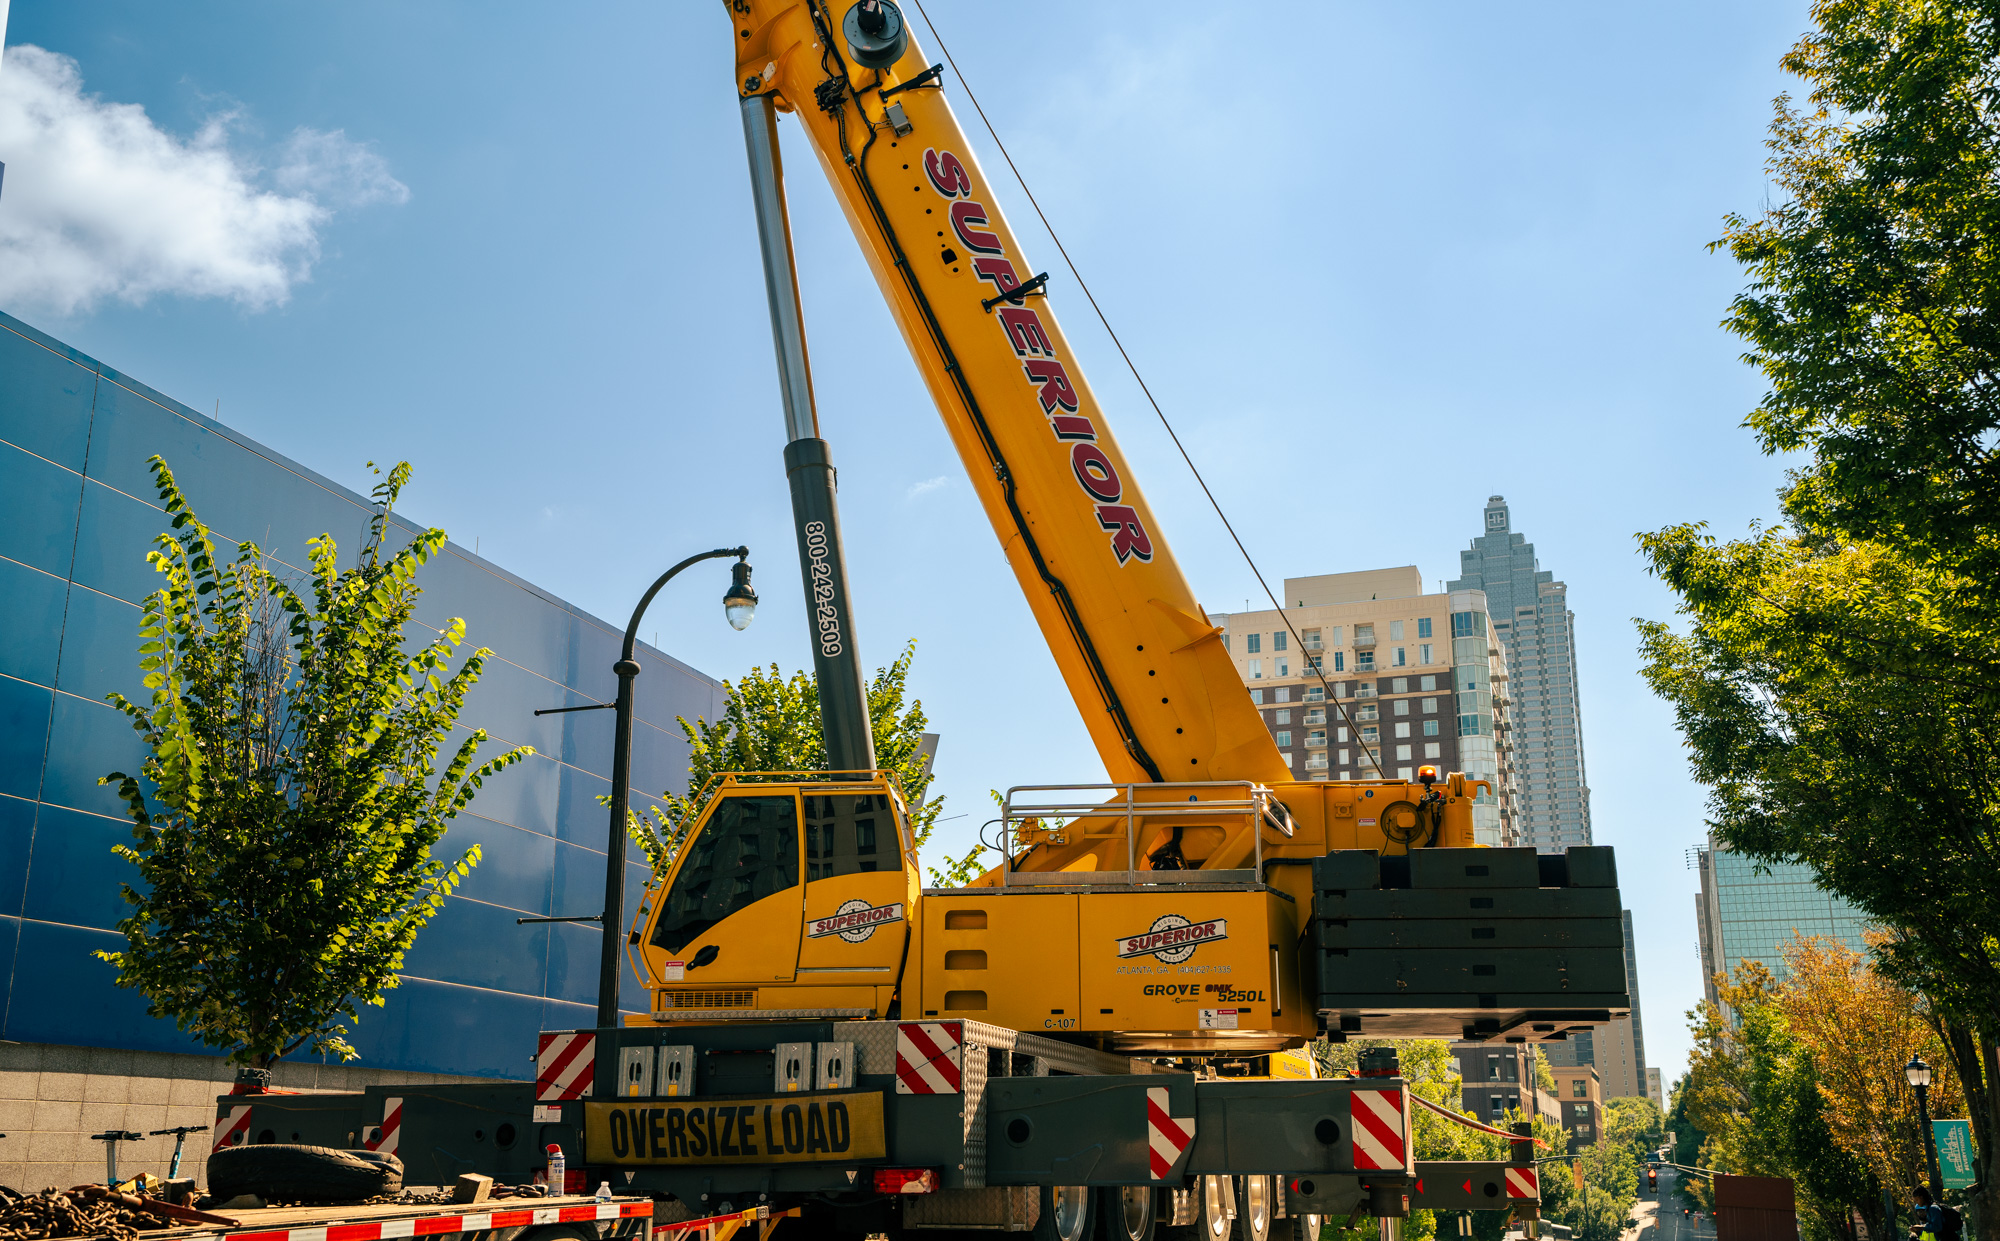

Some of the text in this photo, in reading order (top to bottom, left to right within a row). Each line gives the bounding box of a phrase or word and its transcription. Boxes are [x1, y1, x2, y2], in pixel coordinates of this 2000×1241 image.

[922, 147, 1154, 568] SUPERIOR
[805, 520, 842, 657] 800-242-2509
[842, 902, 866, 912] RIGGING
[815, 906, 895, 933] SUPERIOR
[1156, 918, 1183, 928] RIGGING
[1127, 923, 1217, 952] SUPERIOR
[1160, 949, 1190, 961] ERECTING
[1116, 966, 1154, 975] ATLANTA,
[1177, 965, 1232, 976] (404)627-1335
[1143, 984, 1200, 996] GROVE
[1218, 990, 1266, 1002] 5250L
[1044, 1018, 1076, 1029] C-107
[609, 1101, 851, 1159] OVERSIZE LOAD
